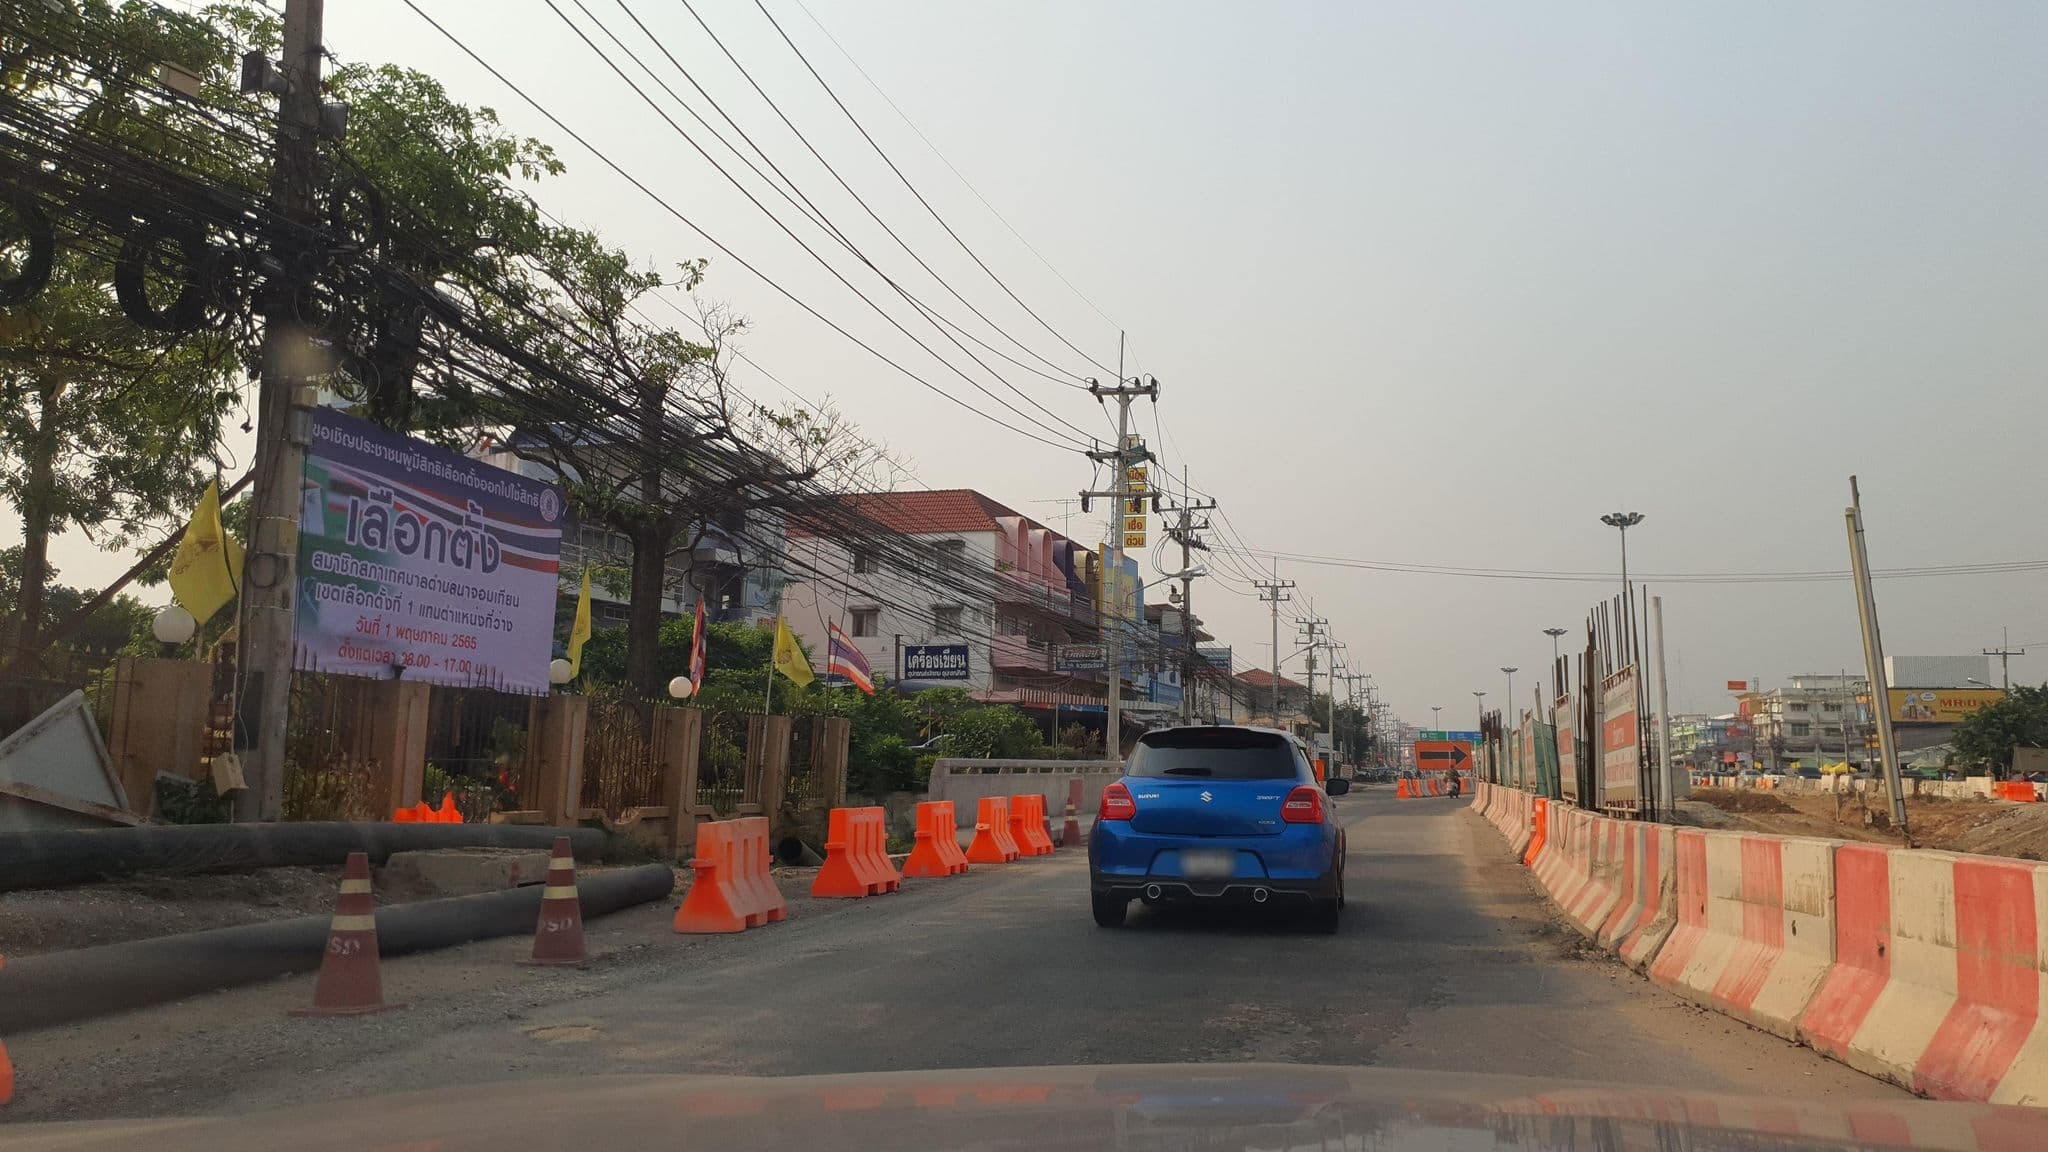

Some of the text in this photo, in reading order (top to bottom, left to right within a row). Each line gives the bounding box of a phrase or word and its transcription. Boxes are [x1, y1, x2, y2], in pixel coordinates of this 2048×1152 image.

[346, 489, 501, 574] เลือกตั้ง
[1126, 535, 1144, 546] ด่วน
[313, 552, 520, 608] สมาชิกสภาเทศบาลตำบลนาจอมเทียน
[316, 583, 513, 633] เขตเลือกตั้งที่ 1 แทนตำแหน่งที่ว่าง
[356, 614, 477, 650] วันที่ 1 พฤษภาคม 2565
[444, 657, 471, 675] 17.00
[908, 646, 967, 669] เครื่องเขียน
